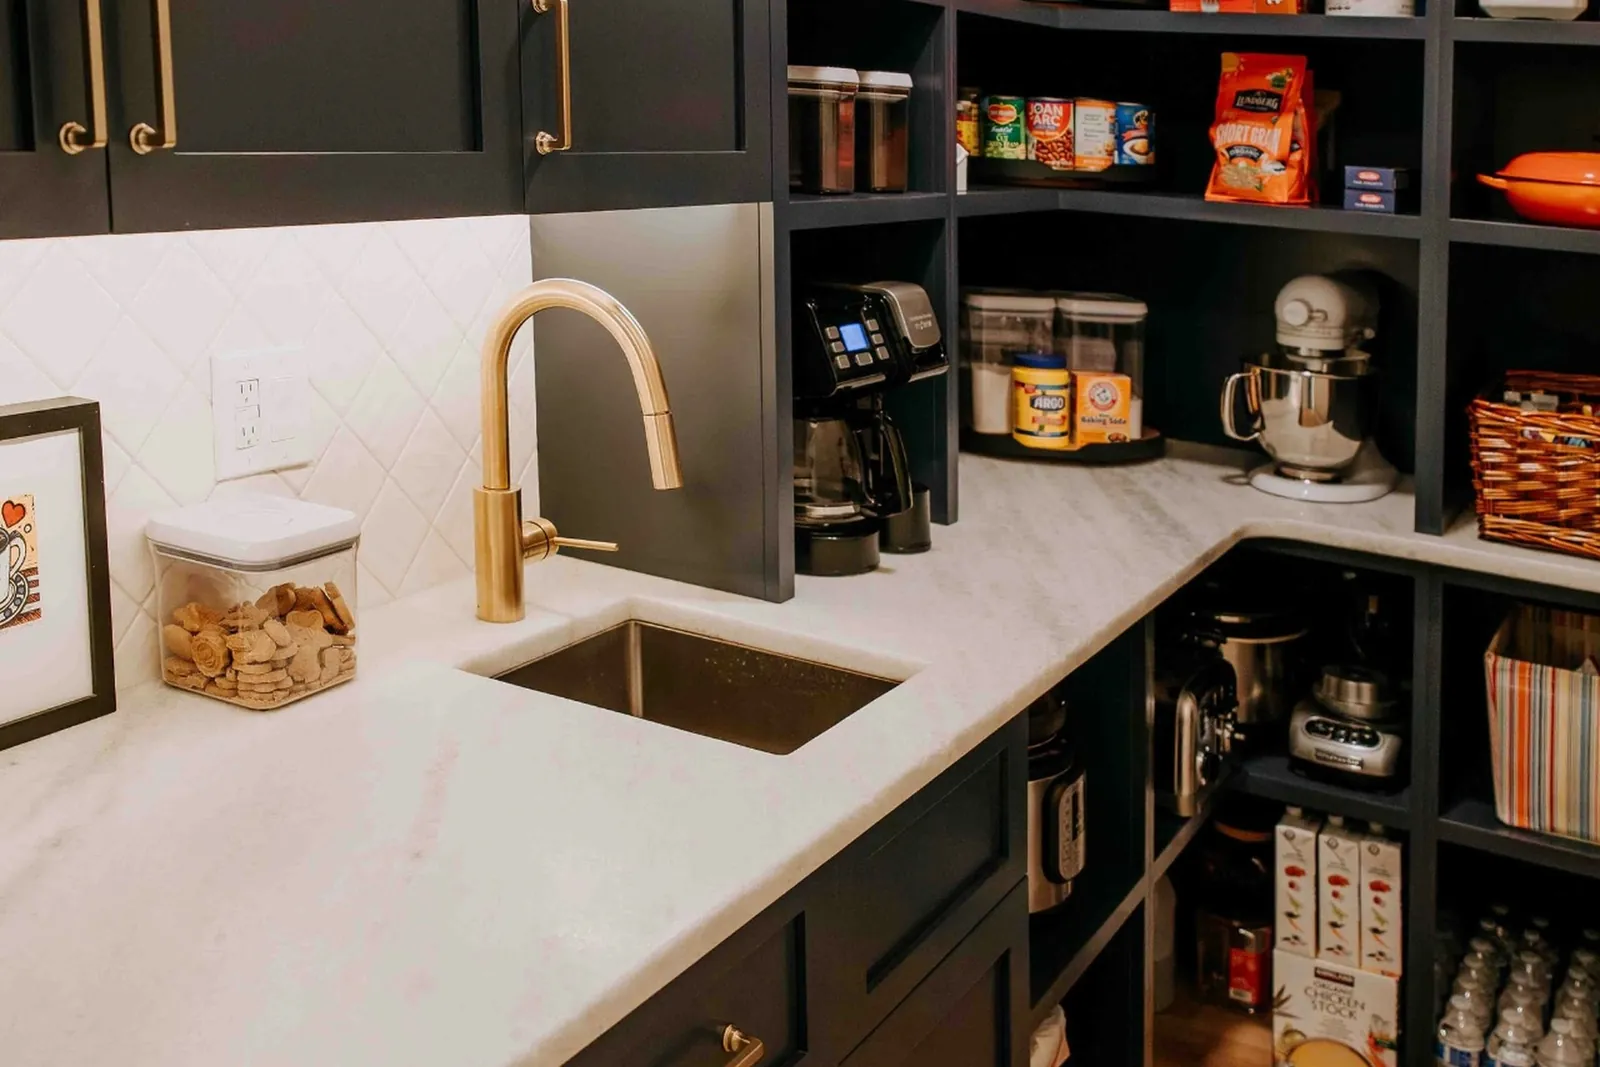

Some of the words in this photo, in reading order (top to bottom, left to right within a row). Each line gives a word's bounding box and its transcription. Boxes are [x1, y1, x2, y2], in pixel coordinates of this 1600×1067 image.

[1028, 103, 1063, 117] JOAN
[1215, 123, 1250, 148] SHORT
[1034, 396, 1064, 409] ARGO
[1081, 416, 1107, 426] Baking
[1109, 417, 1127, 425] Soda
[1304, 986, 1366, 1011] CHICKEN
[1312, 1000, 1358, 1020] STOCK
